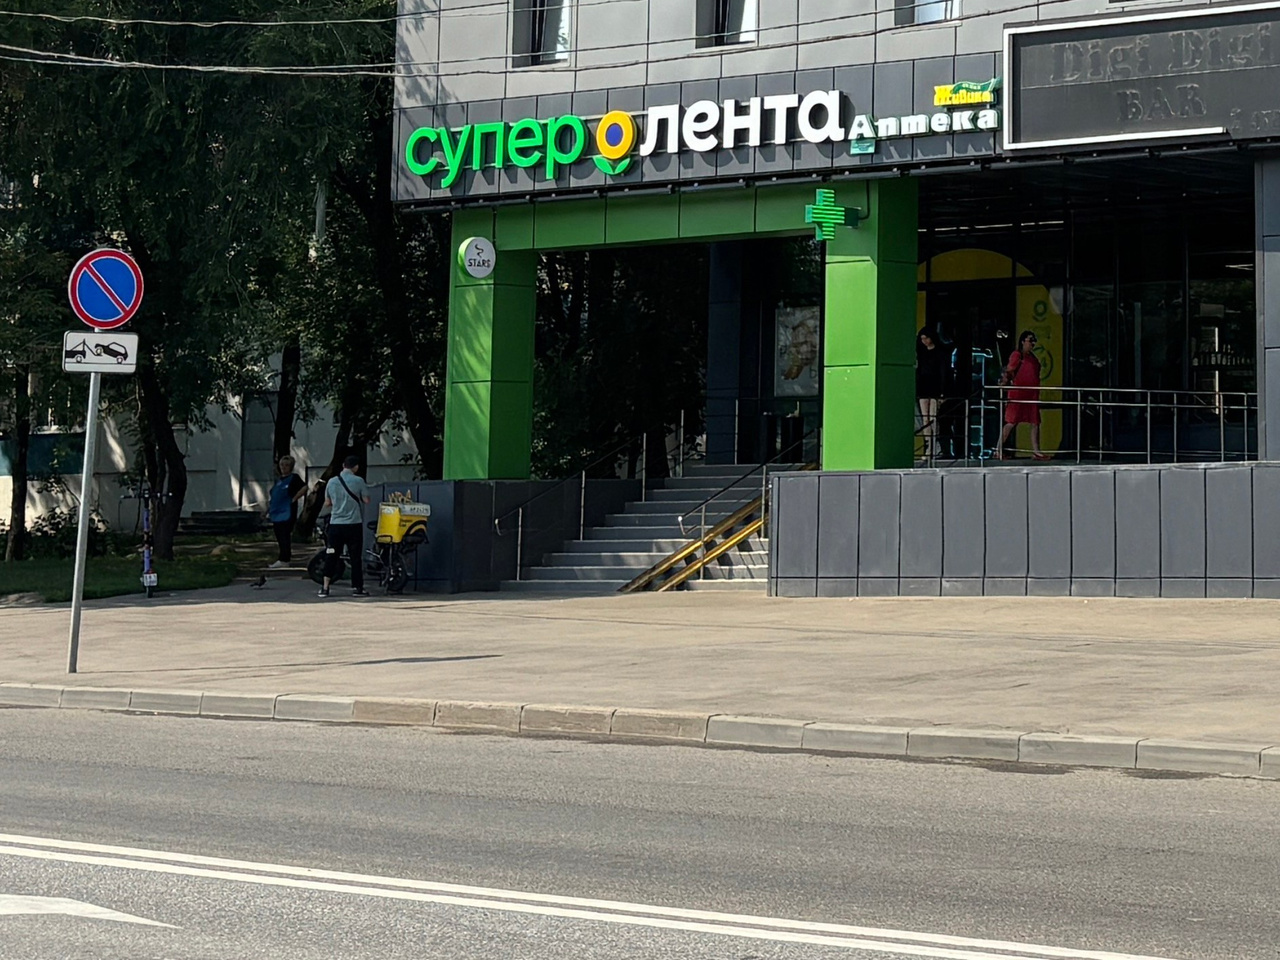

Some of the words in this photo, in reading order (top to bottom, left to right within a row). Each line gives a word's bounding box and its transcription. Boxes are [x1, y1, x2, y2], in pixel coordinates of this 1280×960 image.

[639, 88, 849, 156] лента
[848, 109, 999, 140] Аптека
[467, 257, 491, 269] STARS
